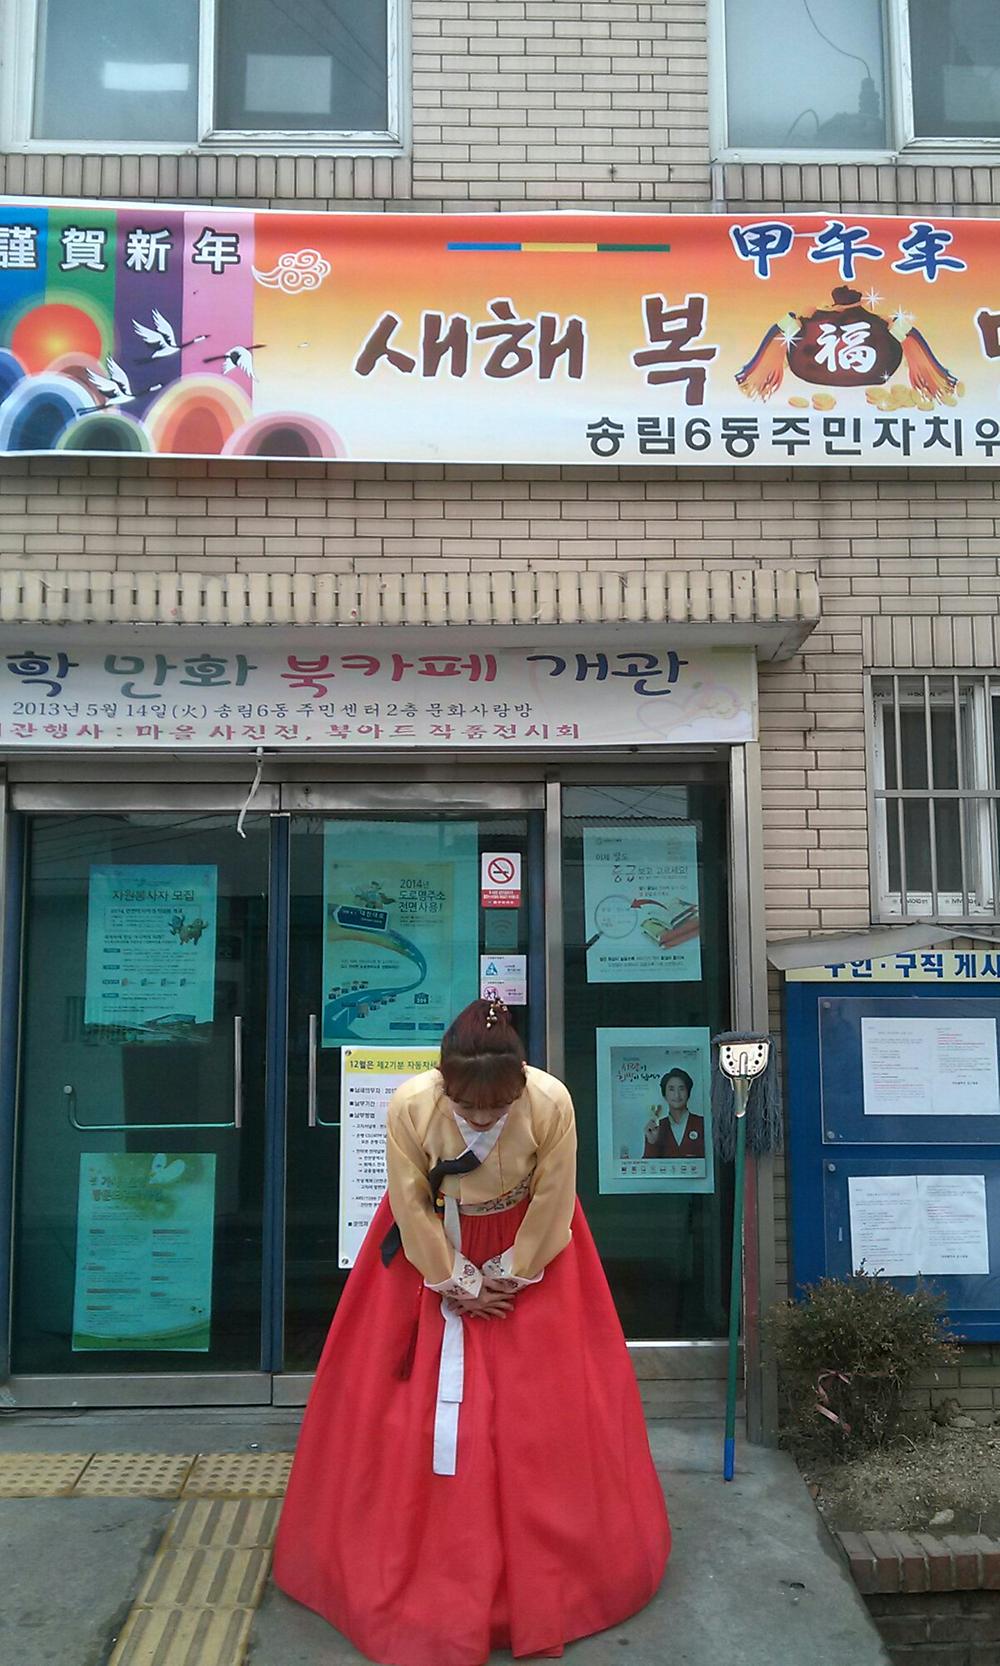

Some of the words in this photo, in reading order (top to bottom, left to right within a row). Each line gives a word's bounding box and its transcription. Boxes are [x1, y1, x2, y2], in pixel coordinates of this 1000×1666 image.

[729, 221, 968, 283] 甲午年
[354, 298, 587, 381] 새해
[632, 294, 718, 408] 복
[813, 322, 877, 374] 福
[104, 653, 258, 699] 만화
[280, 654, 497, 698] 북카페
[526, 651, 689, 696] 개관
[0, 722, 103, 740] 관행사
[12, 702, 80, 717] 2013년
[213, 702, 290, 719] 송림6동
[425, 703, 533, 718] 문화사랑방
[350, 1060, 374, 1070] 12월은
